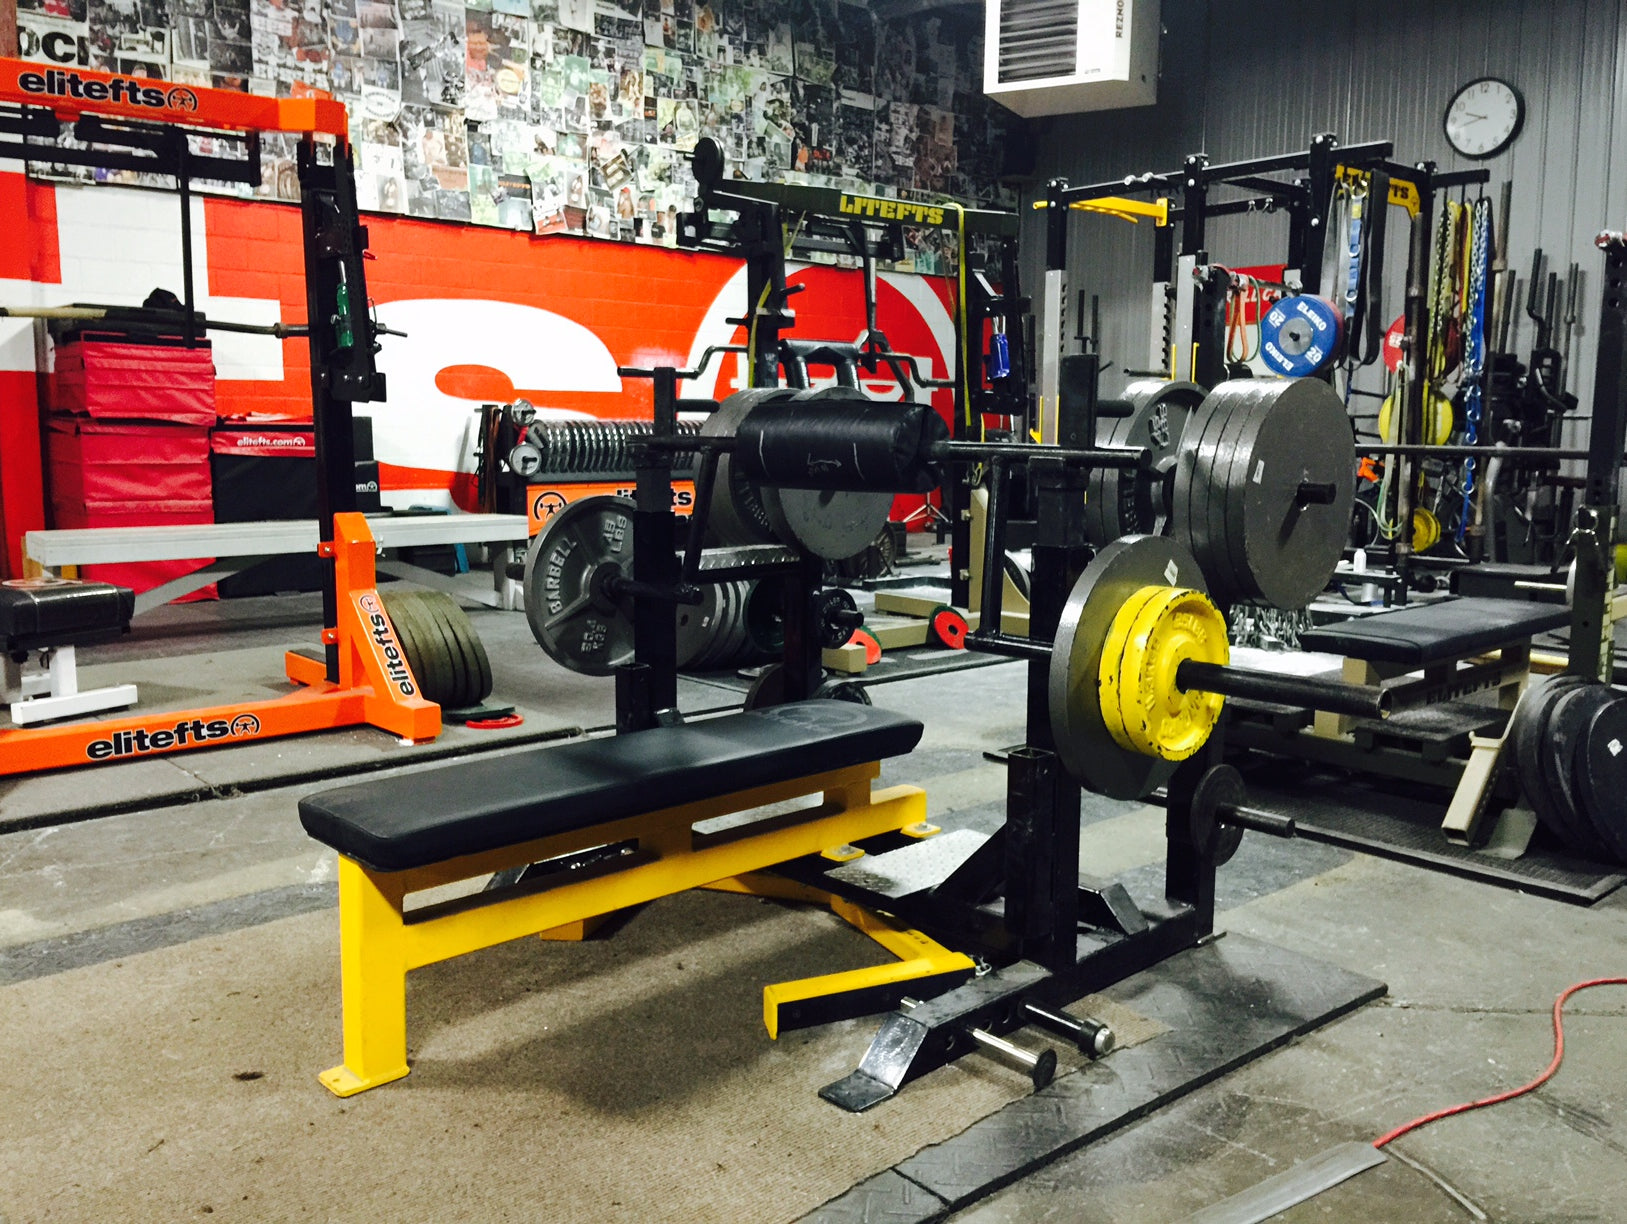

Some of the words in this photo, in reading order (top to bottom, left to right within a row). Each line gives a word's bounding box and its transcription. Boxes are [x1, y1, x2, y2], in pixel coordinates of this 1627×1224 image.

[18, 69, 166, 108] elitefts
[1467, 89, 1475, 100] 11
[1480, 83, 1490, 94] 12
[1455, 101, 1466, 112] 10
[840, 195, 944, 225] LITEFTS
[1269, 311, 1286, 327] 20
[1296, 301, 1327, 331] ELEIKO
[1265, 342, 1294, 371] ELEIKO
[1306, 347, 1322, 363] 20
[611, 514, 628, 553] LBS
[545, 537, 578, 614] BARBELL
[370, 613, 415, 696] elitefts
[86, 719, 231, 760] elitefts
